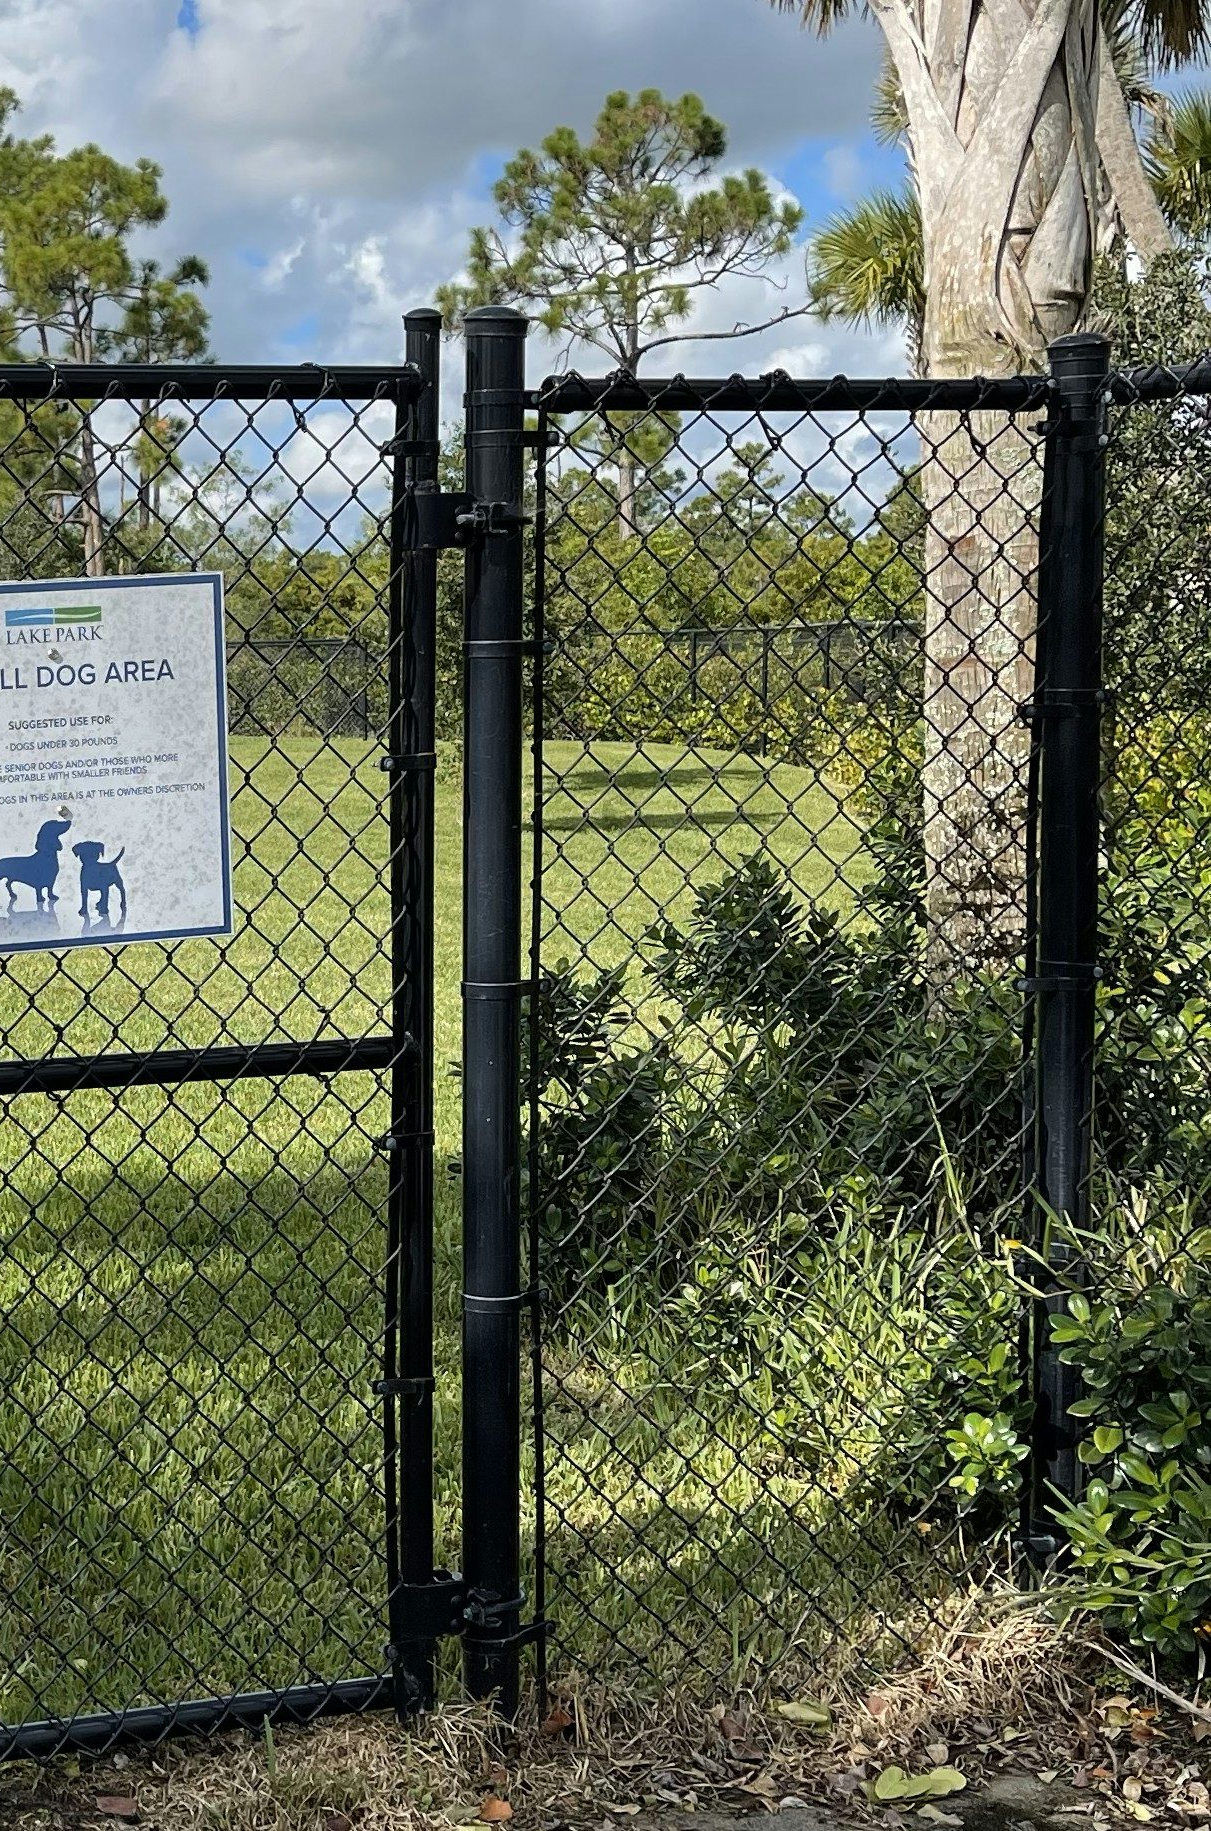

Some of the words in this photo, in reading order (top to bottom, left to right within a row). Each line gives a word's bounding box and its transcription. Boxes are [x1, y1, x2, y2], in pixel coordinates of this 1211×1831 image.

[6, 627, 50, 645] LAKE
[56, 625, 104, 643] PARK
[36, 663, 96, 688] DOG
[105, 659, 175, 683] AREA
[8, 718, 67, 730] SUGGESTED
[70, 716, 89, 726] USE
[91, 715, 113, 725] FOR:
[9, 742, 35, 751] DOGS
[37, 740, 67, 749] UNDER
[69, 739, 79, 748] 30
[82, 737, 118, 746] POUNDS
[4, 763, 36, 773] SENIOR
[38, 761, 63, 771] DOGS
[65, 758, 98, 769] AND/OR
[101, 757, 129, 766] THOSE
[131, 755, 152, 764] WHO
[154, 753, 178, 762] MORE
[48, 772, 69, 780] WITH
[71, 769, 109, 779] SMALLER
[112, 766, 147, 776] FRIENDS
[19, 795, 28, 803] IN
[30, 793, 49, 802] THIS
[51, 792, 74, 801] AREA
[75, 791, 84, 800] IS
[86, 790, 96, 798] AT
[98, 788, 115, 798] THE
[116, 786, 154, 797] OWNERS
[155, 782, 206, 794] DISCRETION
